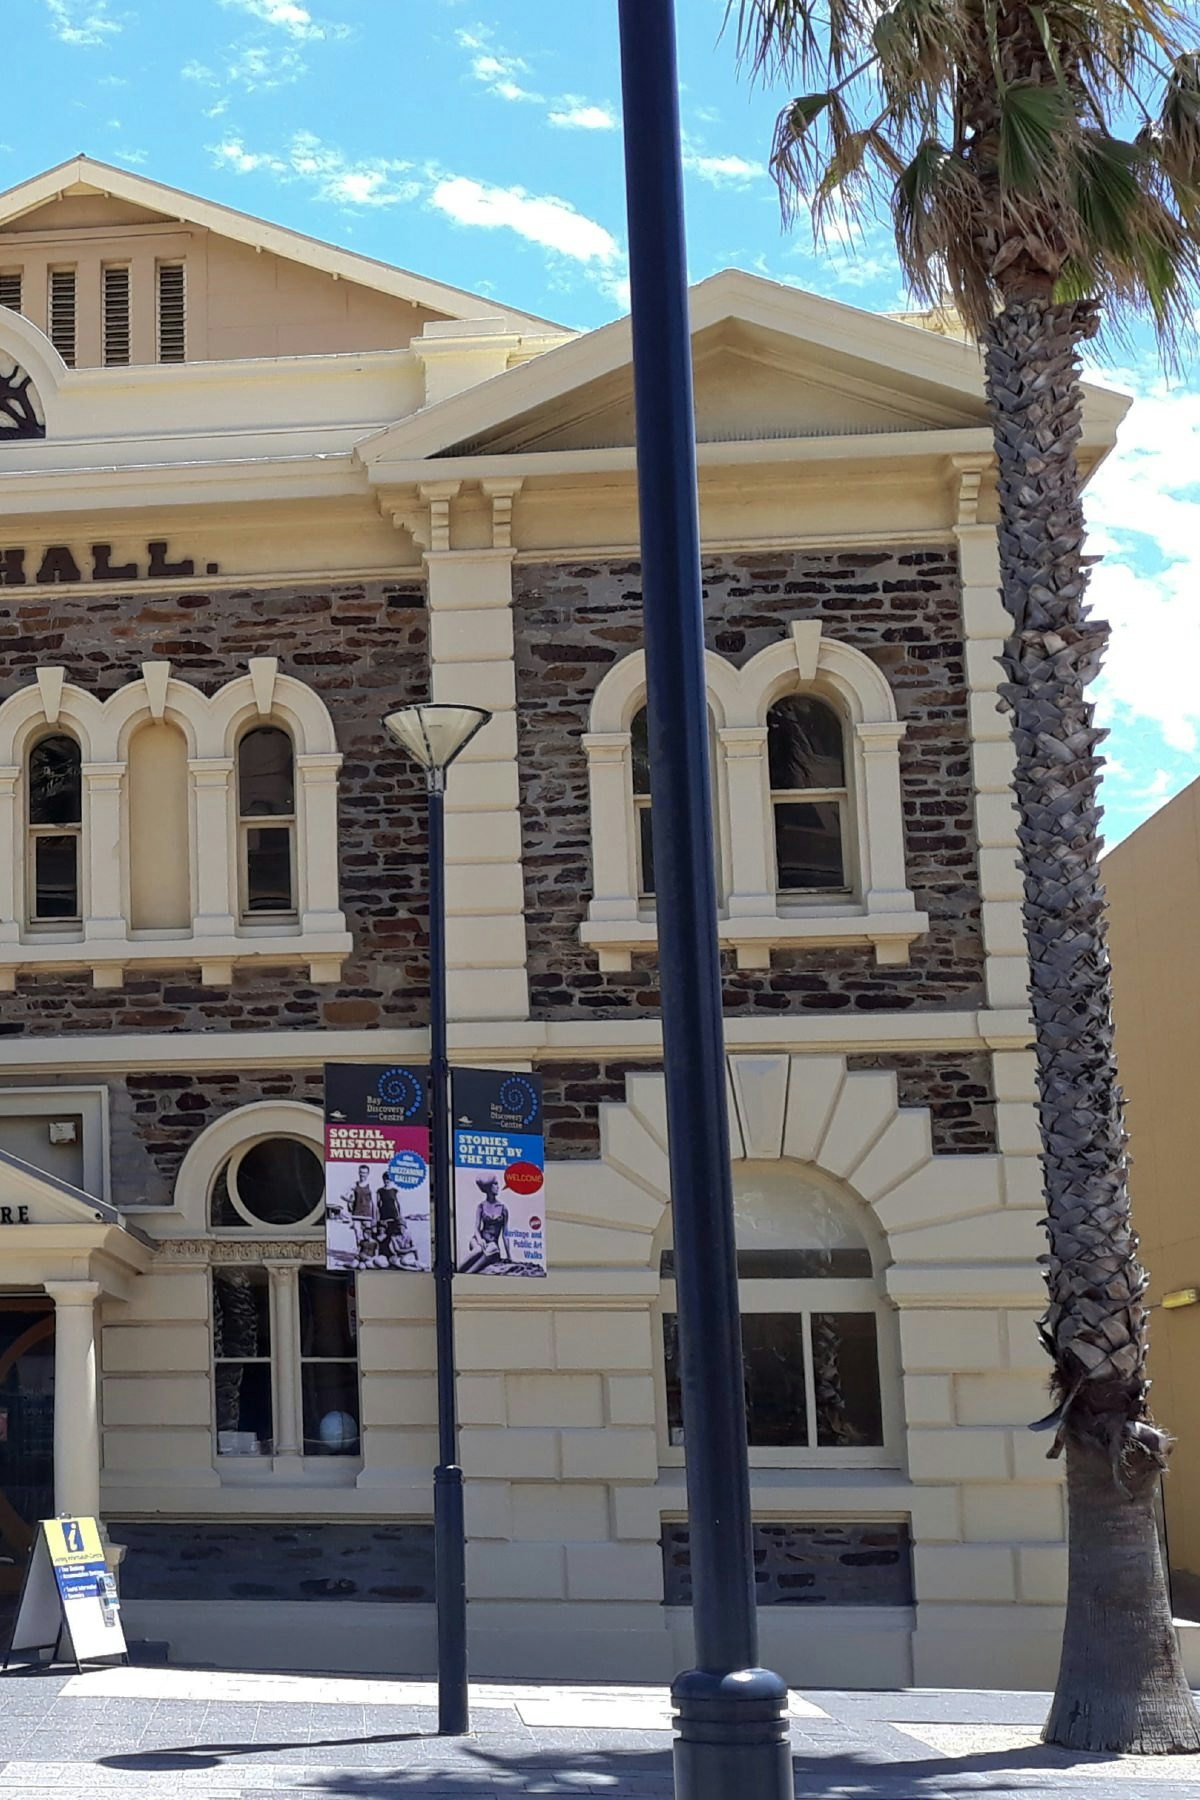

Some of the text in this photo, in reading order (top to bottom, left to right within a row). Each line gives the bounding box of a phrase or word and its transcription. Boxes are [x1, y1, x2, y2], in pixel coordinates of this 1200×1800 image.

[366, 1095, 383, 1105] Bay
[366, 1105, 405, 1114] Discovery
[490, 1103, 503, 1112] Bay
[378, 1113, 405, 1121] Centre
[490, 1112, 523, 1122] Discovery
[500, 1121, 523, 1129] Centre
[329, 1128, 384, 1139] SOCIAL
[329, 1139, 396, 1149] HISTORY
[458, 1134, 509, 1146] STORIES
[329, 1149, 396, 1159] MUSEUM
[459, 1144, 523, 1158] OF LIFE BY
[459, 1154, 508, 1165] THE SEA
[506, 1173, 543, 1183] WELCOME
[531, 1230, 542, 1238] and
[513, 1239, 543, 1249] Public Art
[523, 1250, 543, 1260] Walks
